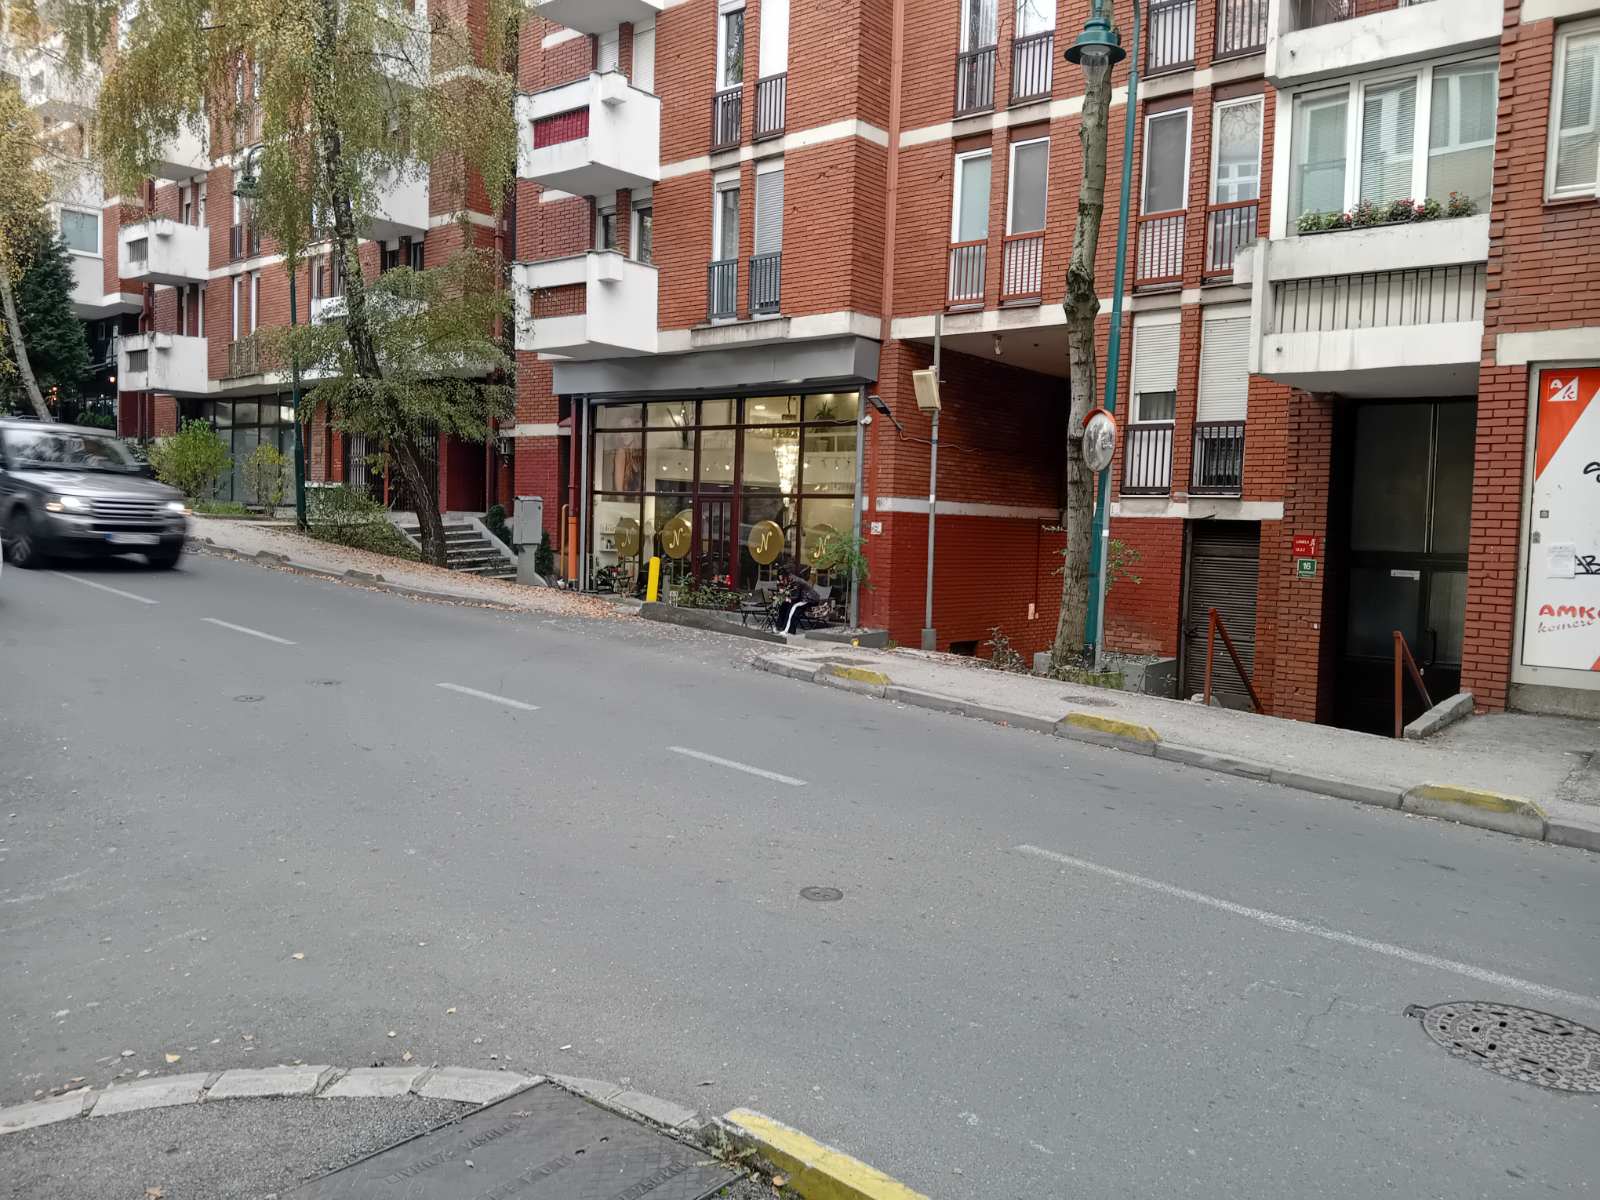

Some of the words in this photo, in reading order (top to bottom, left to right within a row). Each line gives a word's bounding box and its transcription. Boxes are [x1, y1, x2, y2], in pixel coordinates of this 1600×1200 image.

[669, 527, 684, 548] N
[756, 531, 772, 553] N
[1538, 604, 1600, 619] AMK
